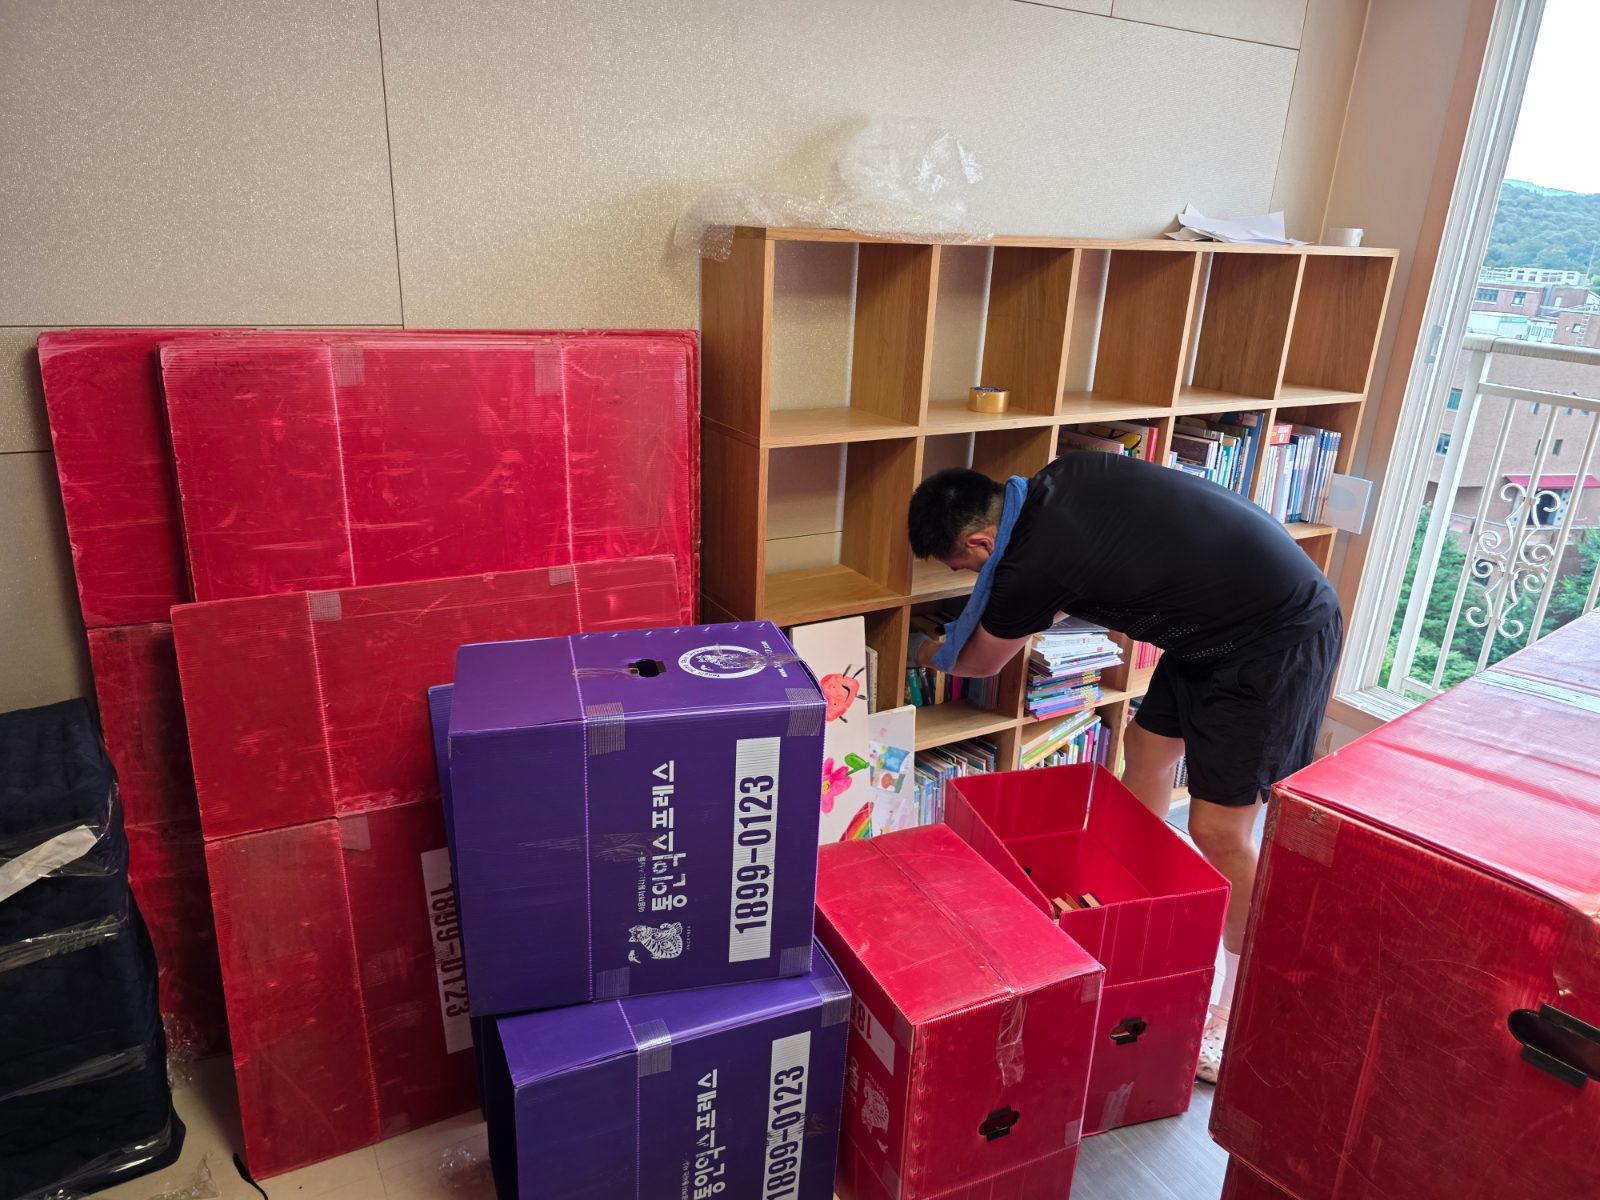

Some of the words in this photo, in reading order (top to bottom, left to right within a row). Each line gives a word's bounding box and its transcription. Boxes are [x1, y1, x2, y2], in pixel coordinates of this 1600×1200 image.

[651, 759, 688, 912] 통인익스프레스
[734, 774, 775, 935] 1899-0123
[693, 1068, 726, 1200] 통인익스프레스
[766, 1064, 806, 1200] 1899-0123
